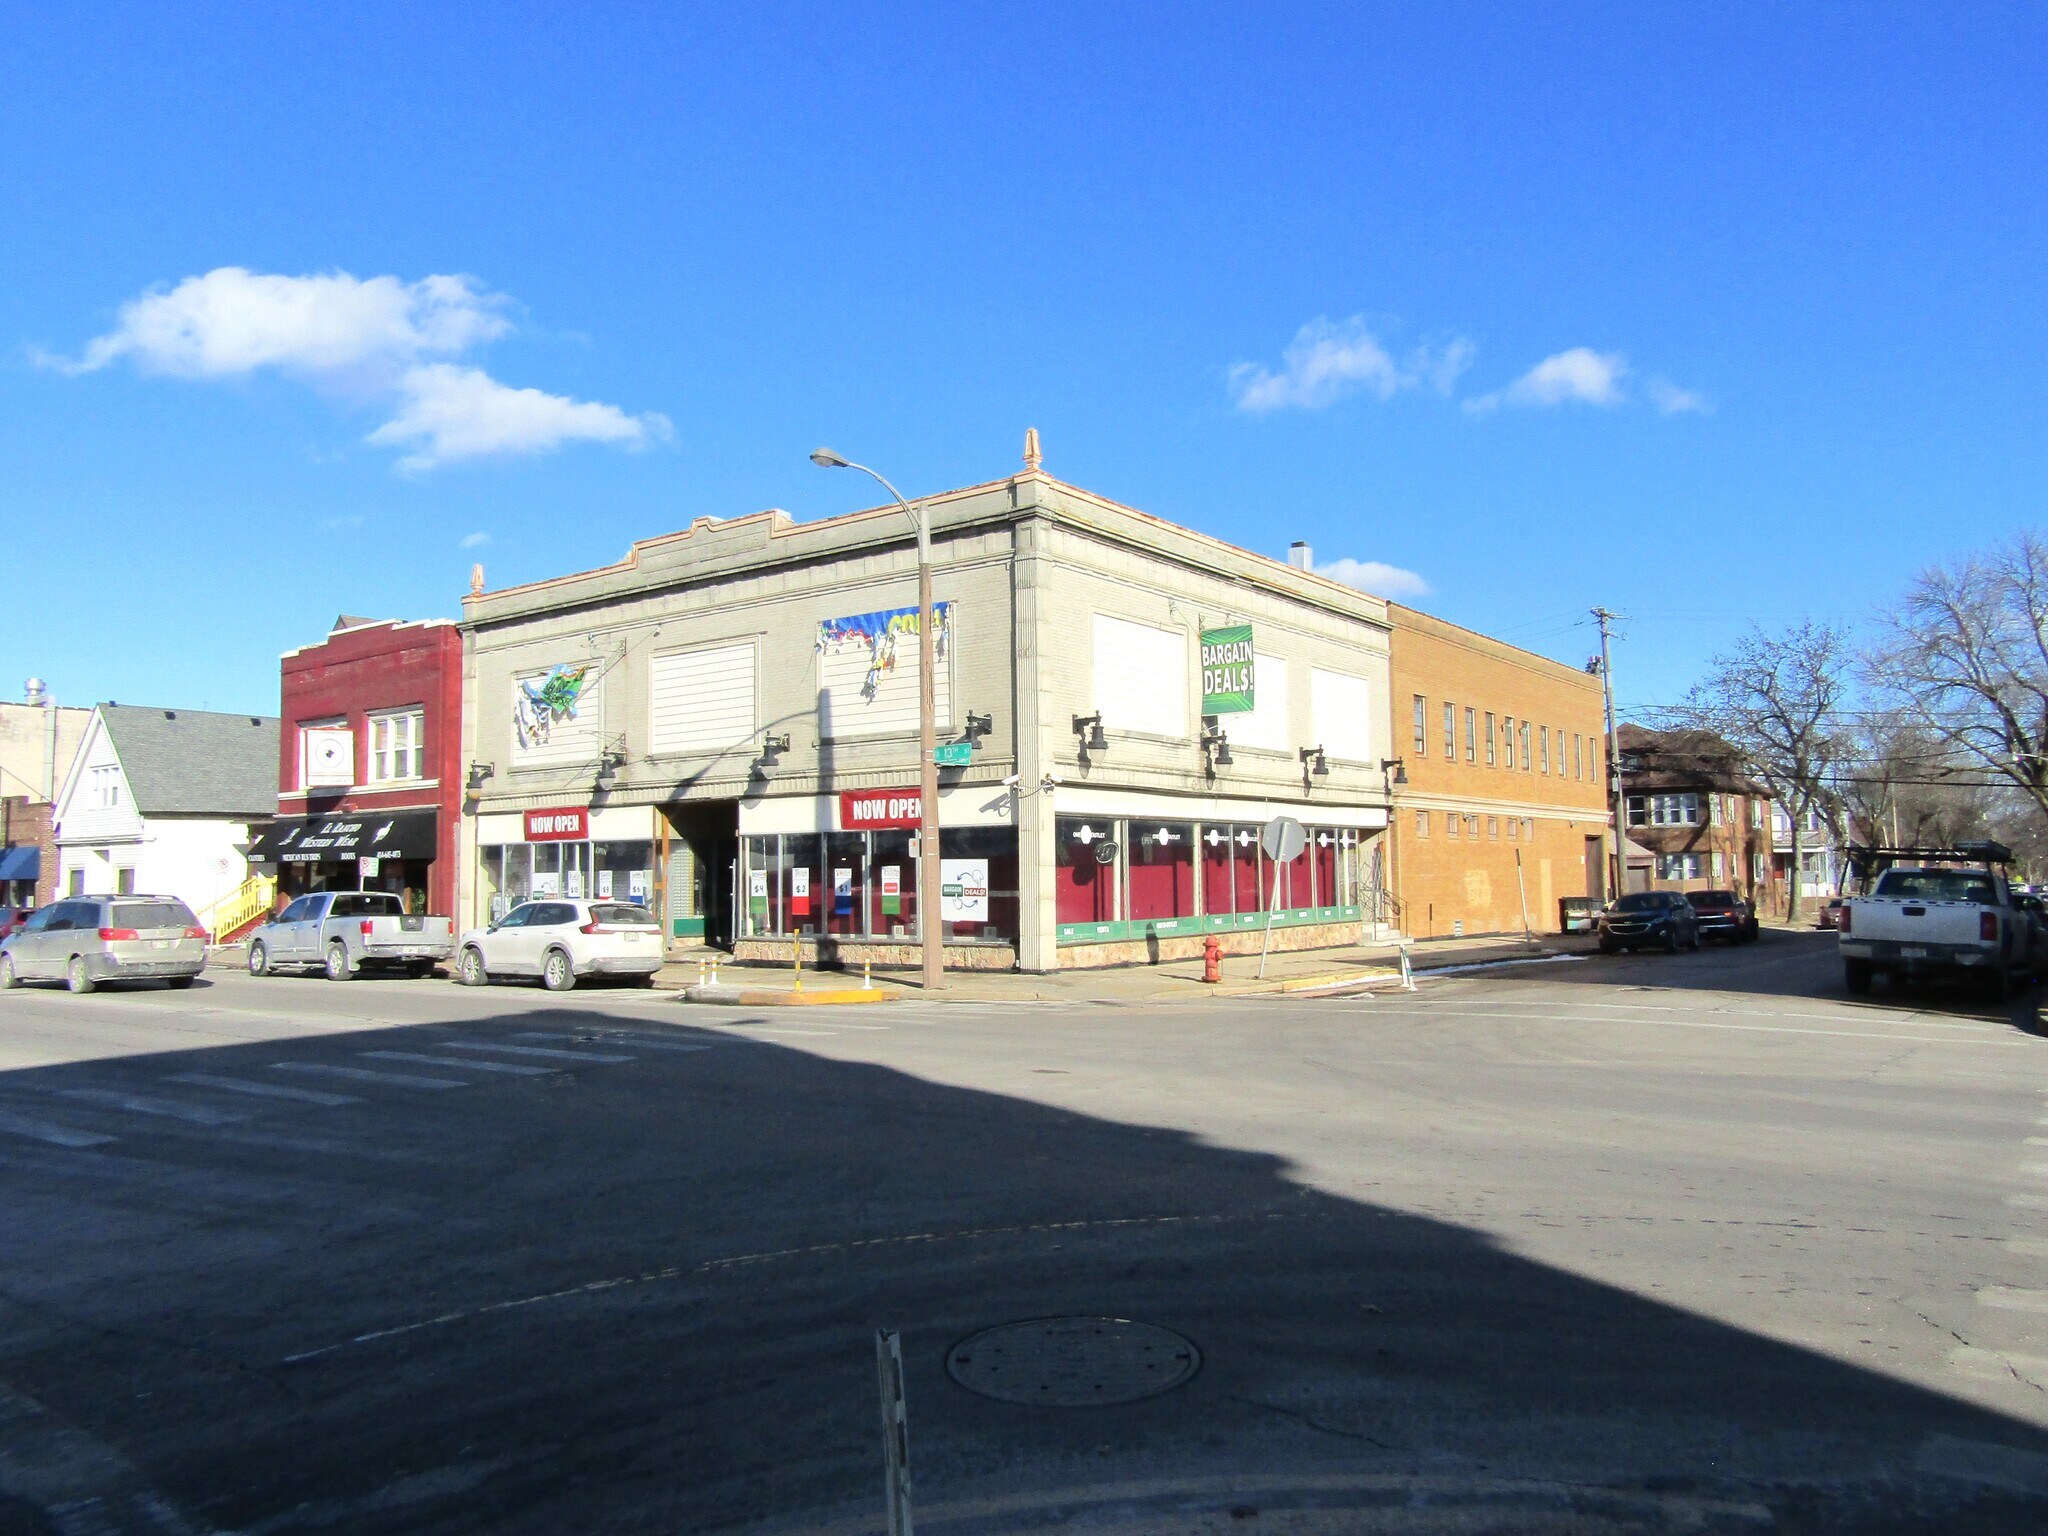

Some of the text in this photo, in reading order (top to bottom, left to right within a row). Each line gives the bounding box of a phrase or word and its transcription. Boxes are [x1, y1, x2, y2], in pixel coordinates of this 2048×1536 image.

[1201, 640, 1253, 667] BARGAIN
[853, 799, 886, 820] NOW
[531, 814, 579, 833] NOW OPEN
